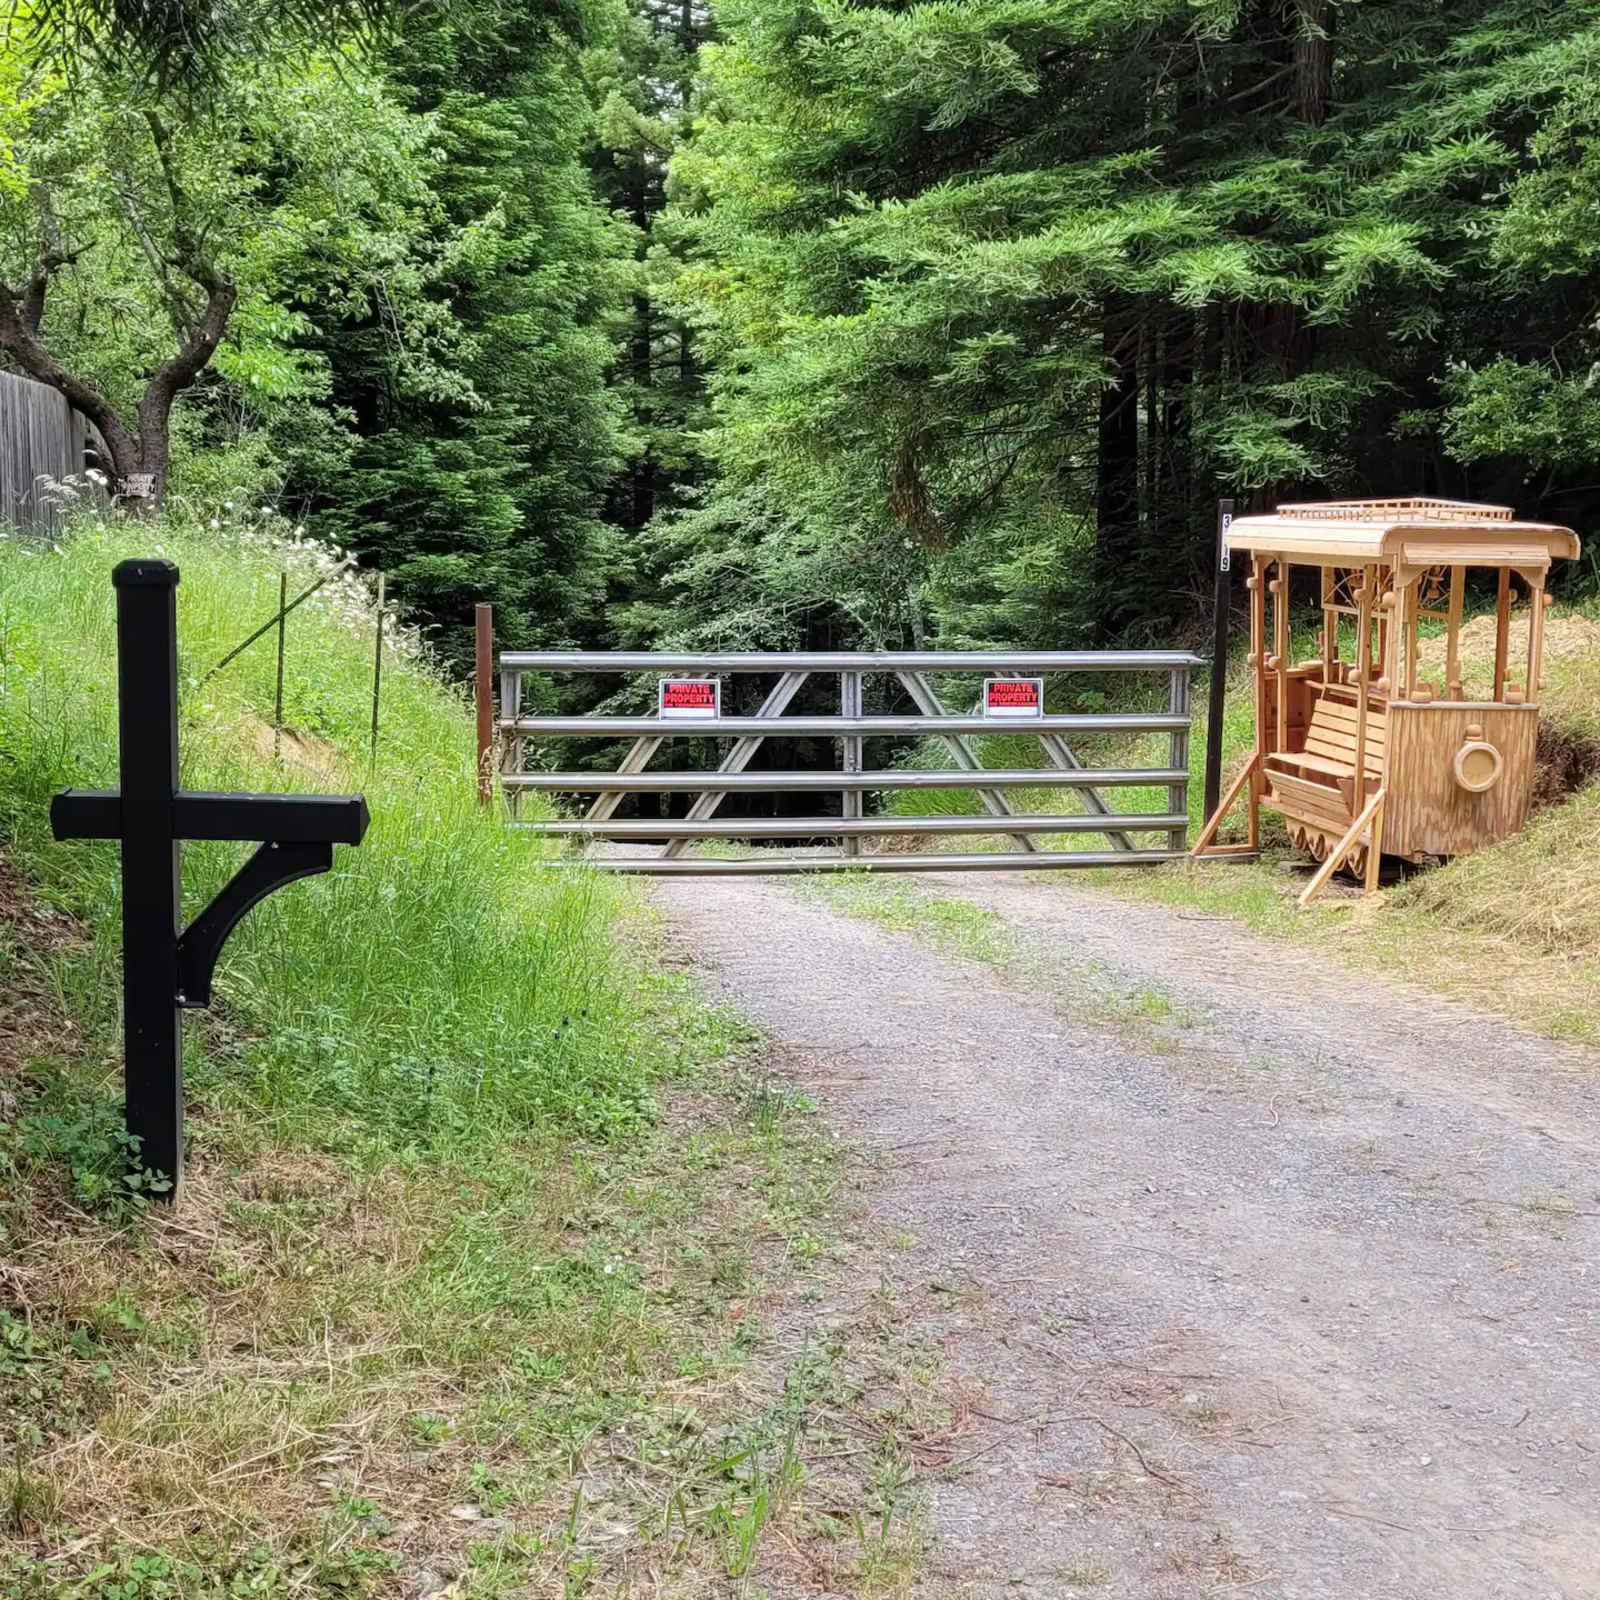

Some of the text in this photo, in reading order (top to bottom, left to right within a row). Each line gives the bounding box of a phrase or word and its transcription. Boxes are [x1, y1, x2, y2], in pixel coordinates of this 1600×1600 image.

[669, 684, 710, 693] PRIVATE
[994, 683, 1033, 692] PRIVATE
[665, 693, 713, 703] PROPERTY
[989, 692, 1037, 702] PROPERTY
